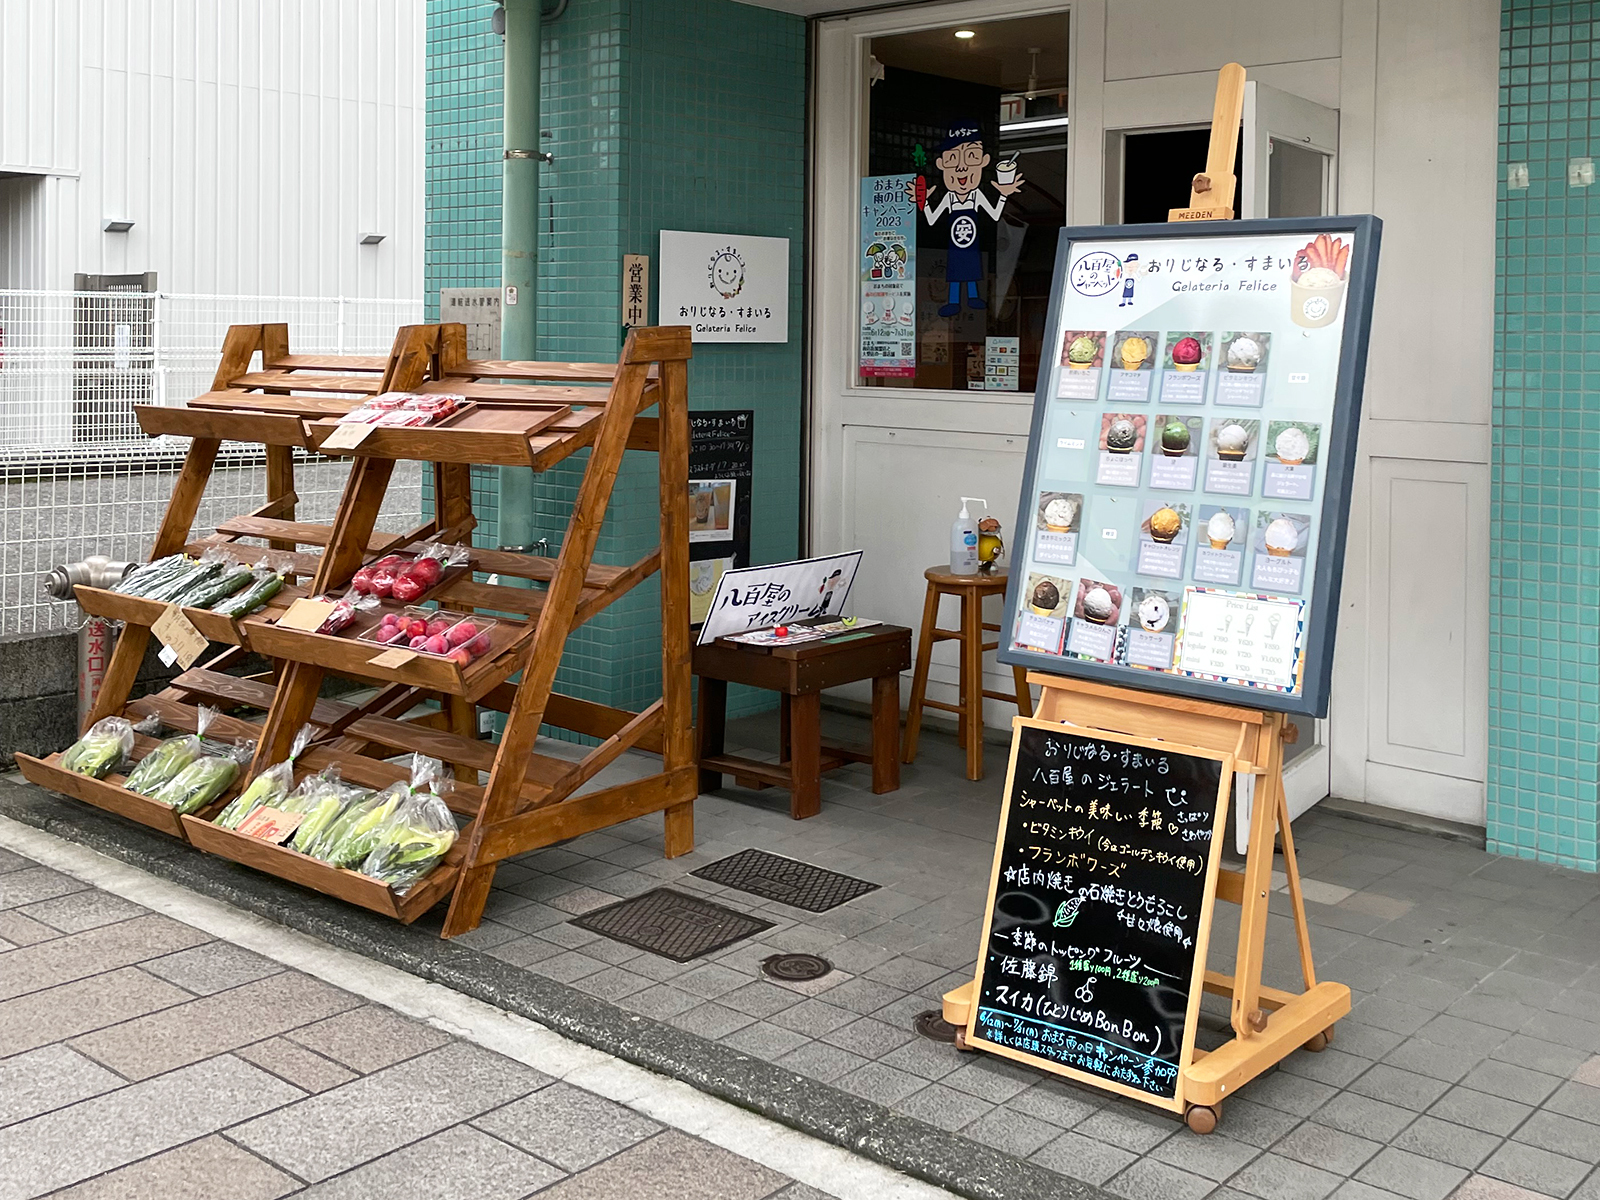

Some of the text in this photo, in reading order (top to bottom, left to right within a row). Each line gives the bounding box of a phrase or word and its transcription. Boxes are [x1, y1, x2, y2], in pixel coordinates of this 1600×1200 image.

[949, 128, 978, 138] しゃちょー
[874, 179, 903, 190] おまち
[874, 191, 903, 204] 雨の日
[863, 203, 914, 217] キャンペーン
[1178, 211, 1212, 220] MEEDEN
[876, 216, 902, 227] 2023
[1078, 258, 1115, 273] 八百屋
[1148, 254, 1310, 273] おりじなる・すまいる
[1076, 274, 1116, 289] シャーベット
[1172, 280, 1278, 292] Gelateria Felice
[628, 263, 643, 325] 営業中
[679, 306, 772, 318] おりじなる・すまいる
[696, 324, 756, 332] Gelateria Felice
[1265, 556, 1292, 565] ヨーグルト
[719, 583, 791, 610] 八百屋の
[1226, 600, 1259, 612] Price List
[88, 621, 105, 672] 送水口
[1045, 738, 1170, 774] おりじなる・すまいる
